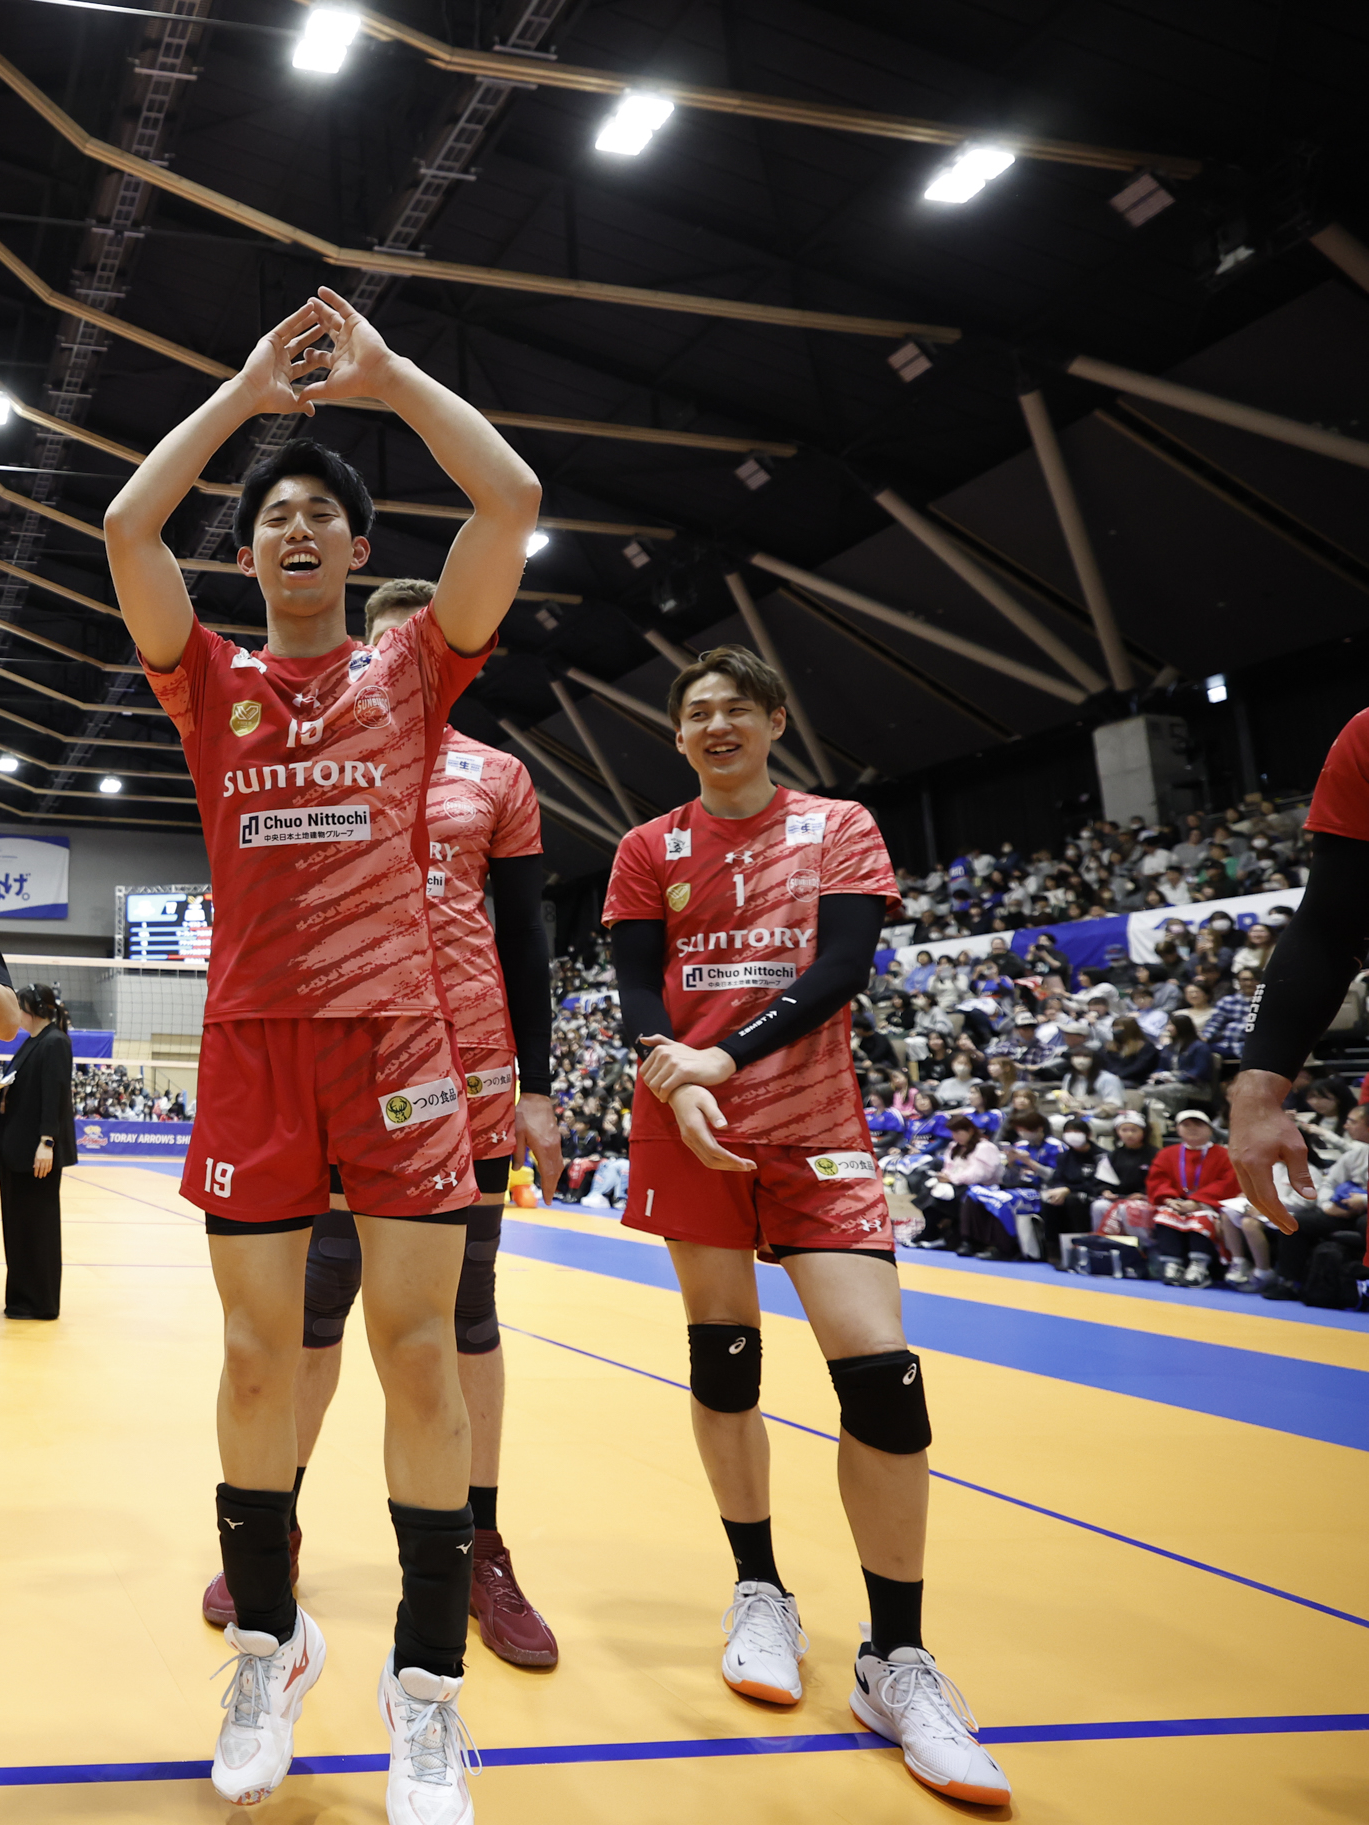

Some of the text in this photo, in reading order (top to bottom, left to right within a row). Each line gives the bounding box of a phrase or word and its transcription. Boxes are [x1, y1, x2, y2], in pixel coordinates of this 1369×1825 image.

[223, 759, 388, 798] SUNTORY
[263, 810, 368, 830] Chuo Nittochi
[263, 829, 354, 842] 中央日本土地建物グループ
[732, 873, 745, 907] 1
[675, 927, 815, 957] SUNTORY
[707, 965, 794, 979] Chuo Nittochi
[483, 1073, 512, 1087] つの食品
[412, 1087, 457, 1109] つの食品
[109, 1132, 138, 1143] TORAY
[138, 1133, 175, 1145] ARROWS
[204, 1156, 235, 1199] 19
[644, 1188, 655, 1217] 1
